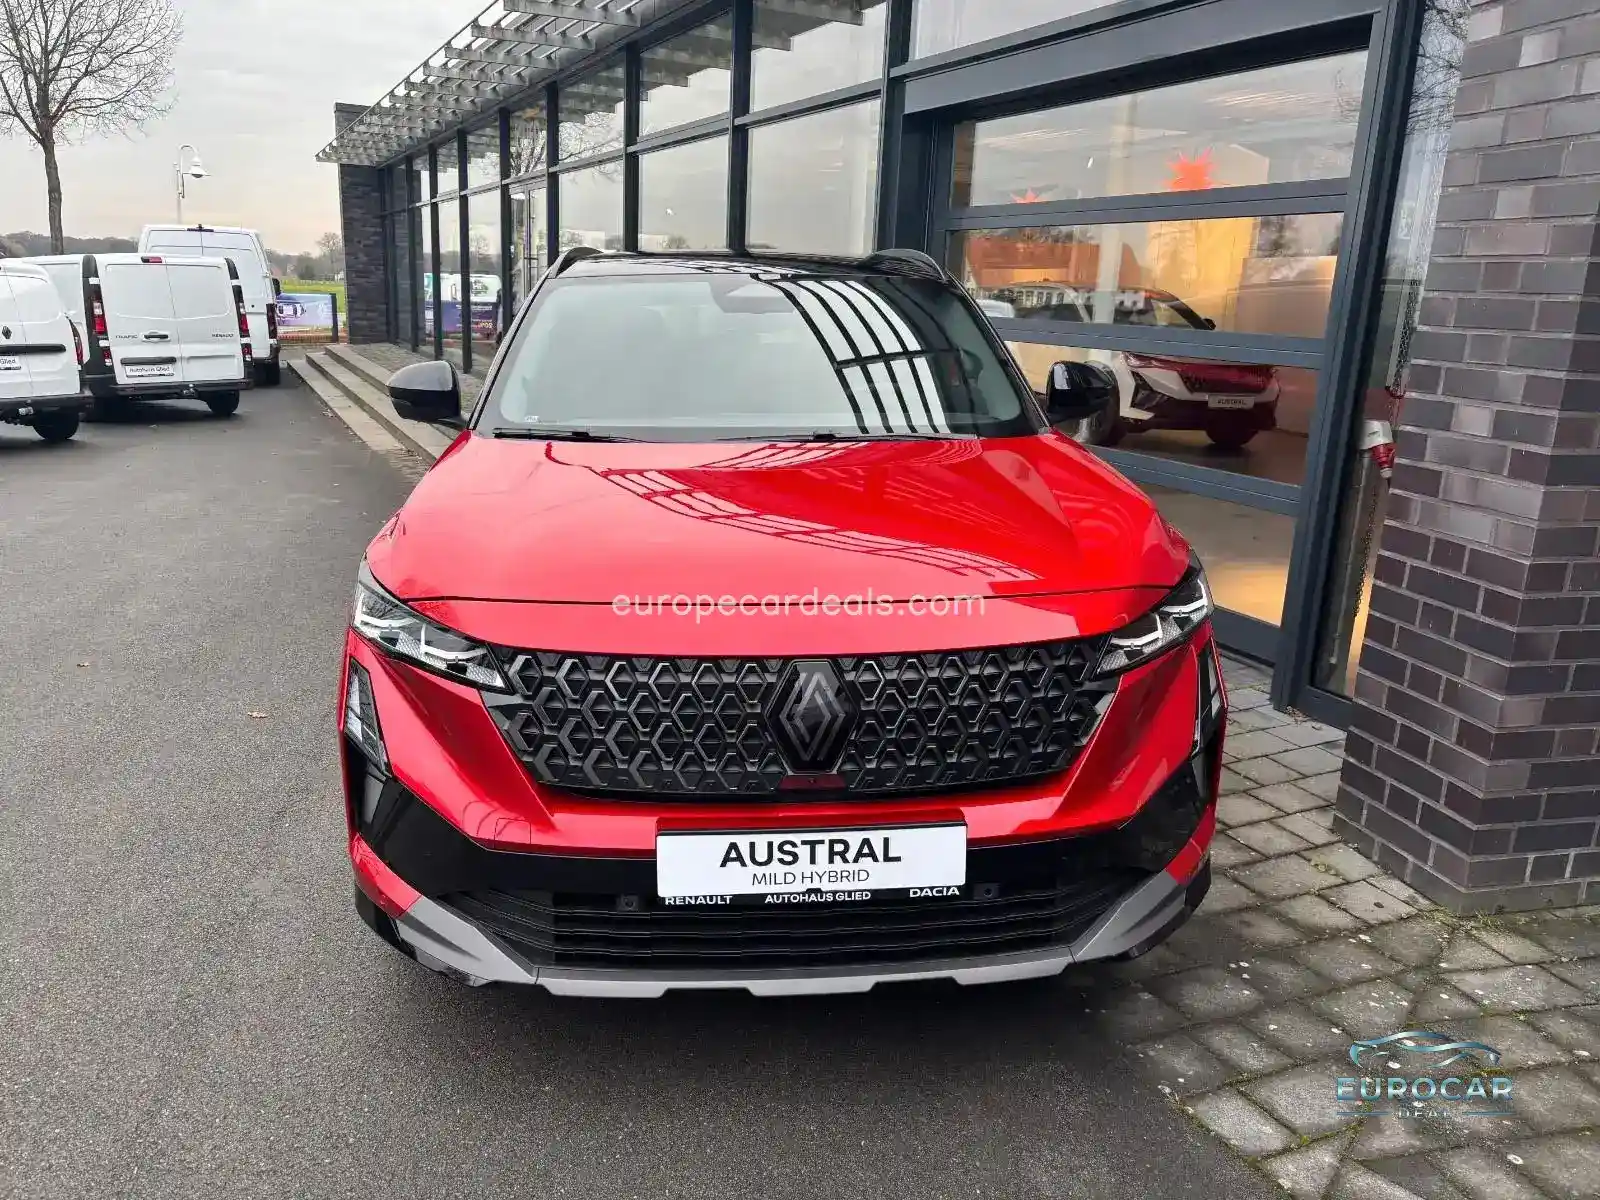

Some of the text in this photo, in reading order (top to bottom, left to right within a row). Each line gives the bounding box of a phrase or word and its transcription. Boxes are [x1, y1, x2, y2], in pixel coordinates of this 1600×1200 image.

[719, 837, 902, 868] AUSTRAL
[751, 869, 870, 886] MILD HYBRID
[664, 886, 960, 905] RENAULT AUTOHAUS GLIED DACIA
